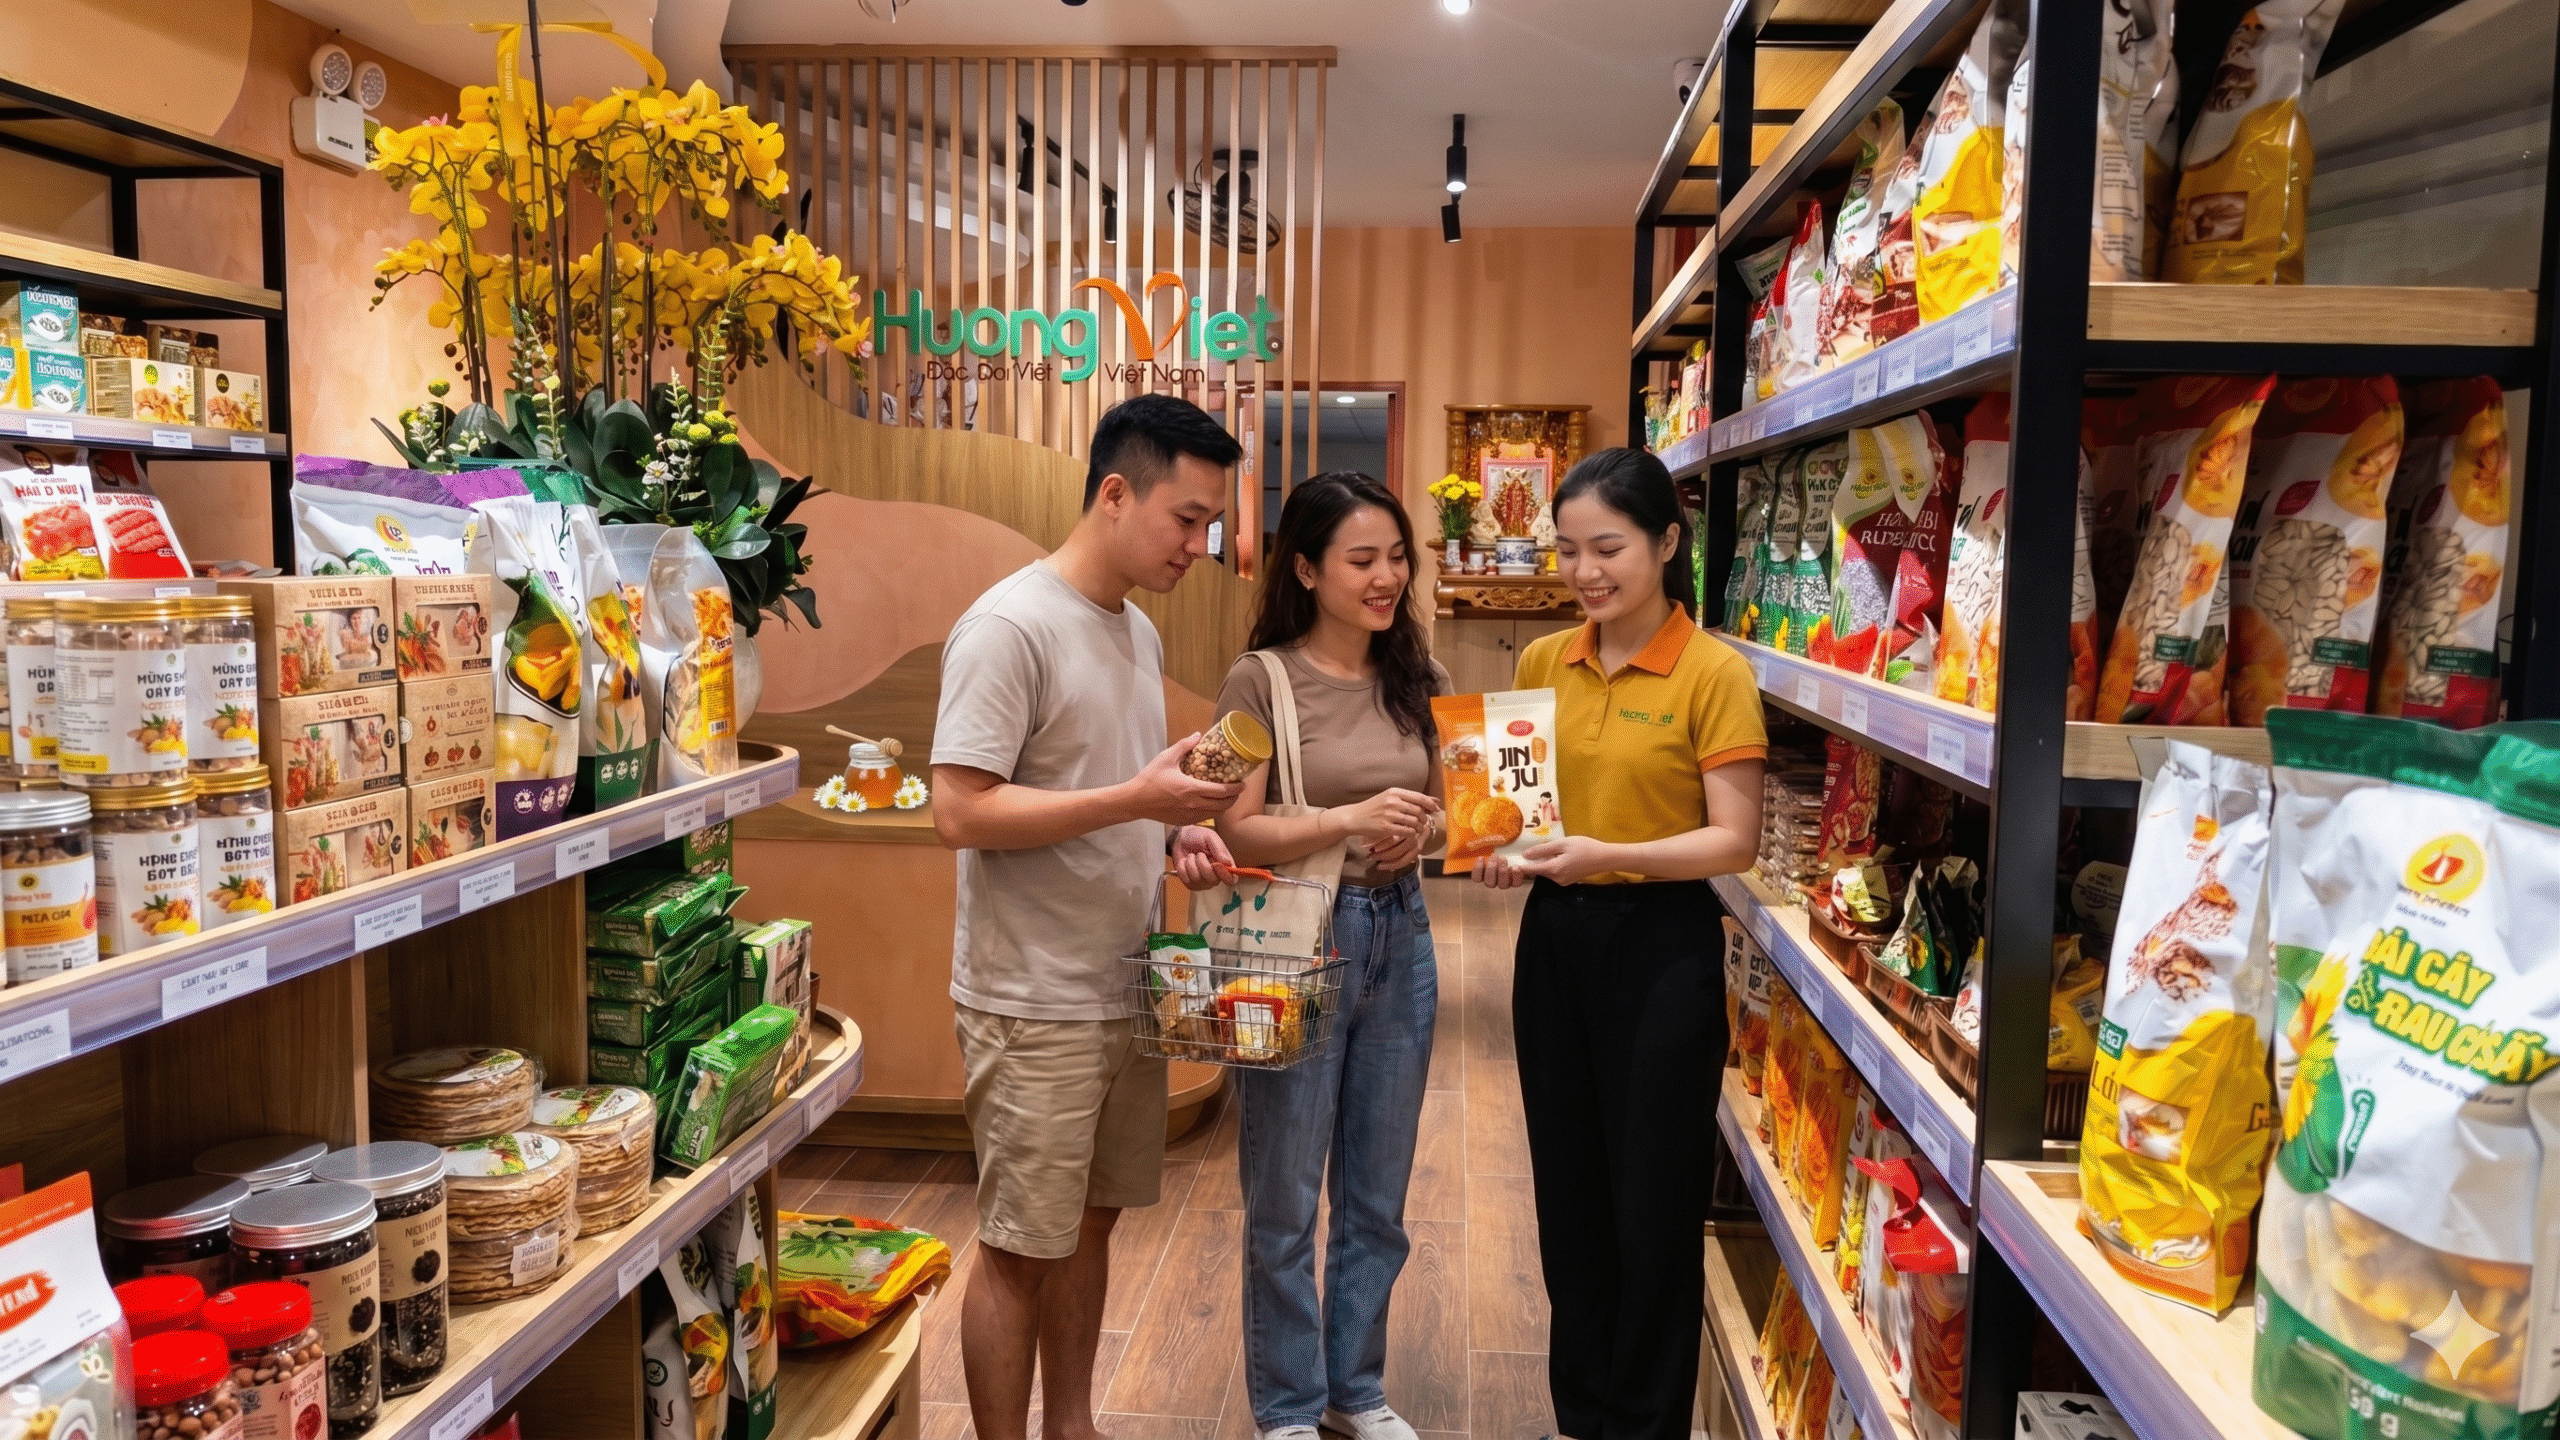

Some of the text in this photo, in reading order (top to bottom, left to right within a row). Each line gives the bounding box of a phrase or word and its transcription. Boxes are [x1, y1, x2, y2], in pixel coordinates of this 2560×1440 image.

[873, 271, 1277, 382] Huong Viet
[1498, 745, 1531, 772] JIN
[1511, 766, 1539, 793] JU
[2372, 987, 2459, 1055] RAU
